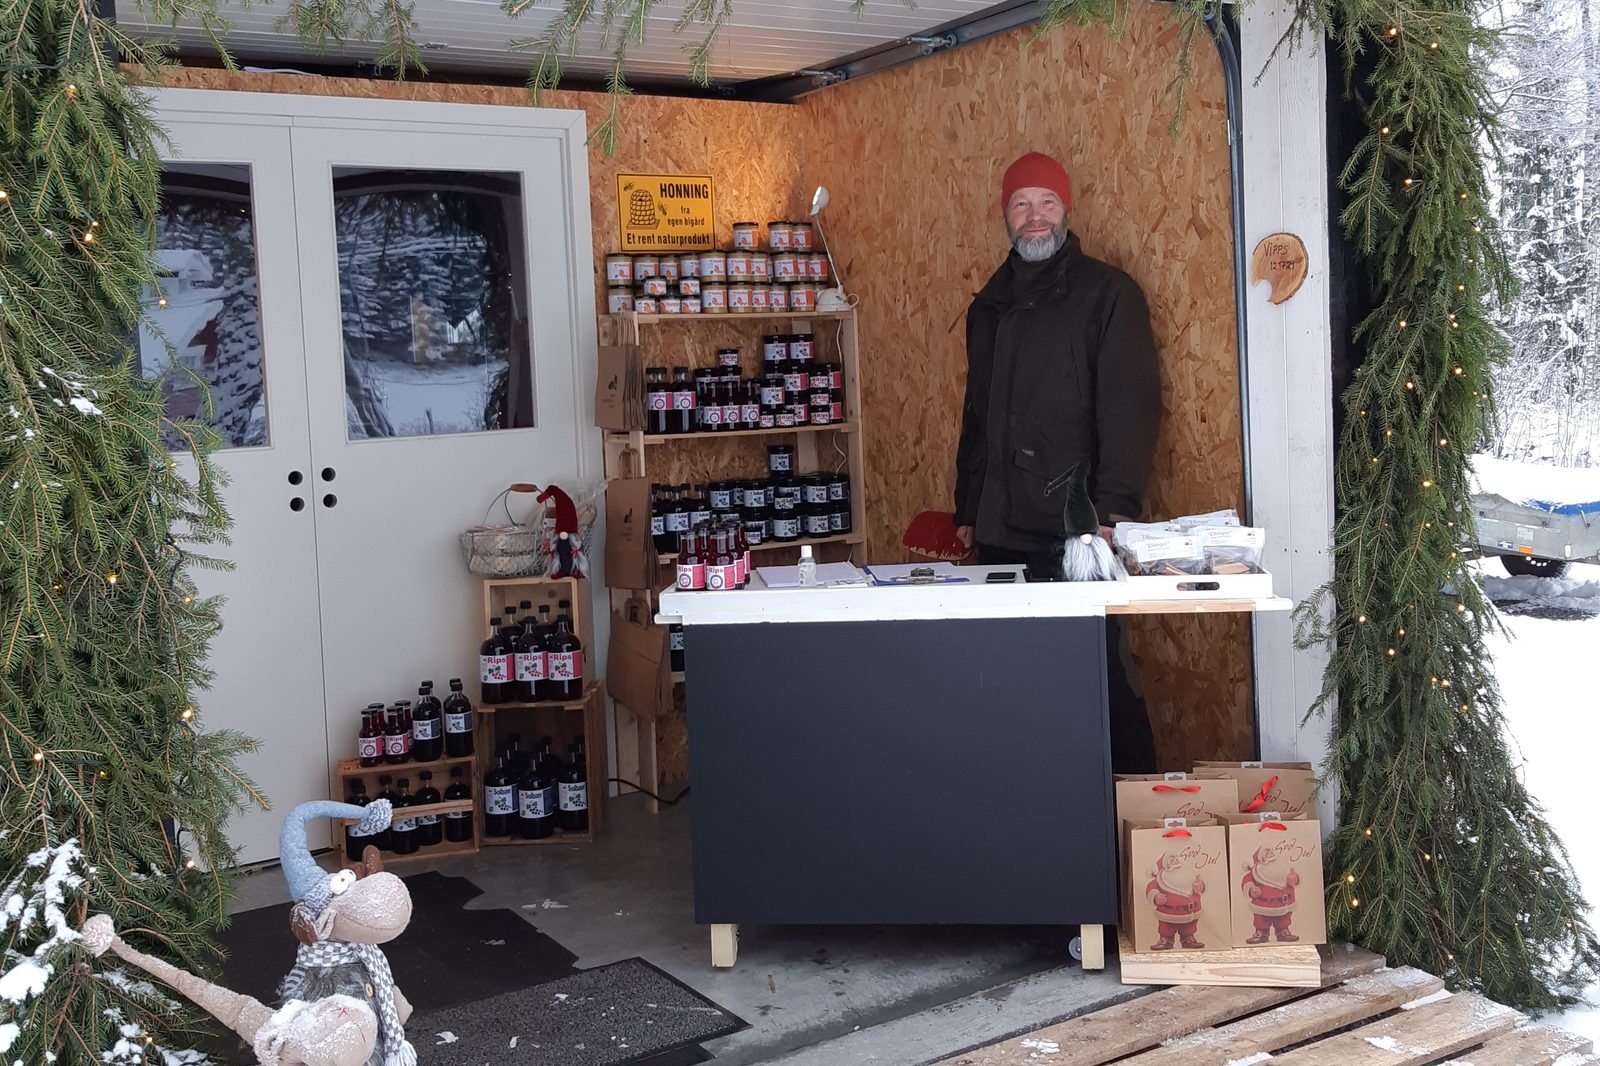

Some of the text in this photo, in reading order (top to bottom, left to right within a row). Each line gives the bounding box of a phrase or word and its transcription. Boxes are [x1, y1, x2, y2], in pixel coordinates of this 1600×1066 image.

[660, 183, 709, 199] HONNING
[680, 206, 690, 214] fra
[667, 217, 705, 227] egen bigård
[626, 233, 710, 247] Et rent naturprodukt
[487, 656, 506, 664] Rips
[523, 654, 542, 662] Rips
[553, 654, 572, 662] Rips
[1177, 801, 1205, 819] God
[1275, 838, 1316, 862] God Jul
[1180, 844, 1221, 869] God Jul
